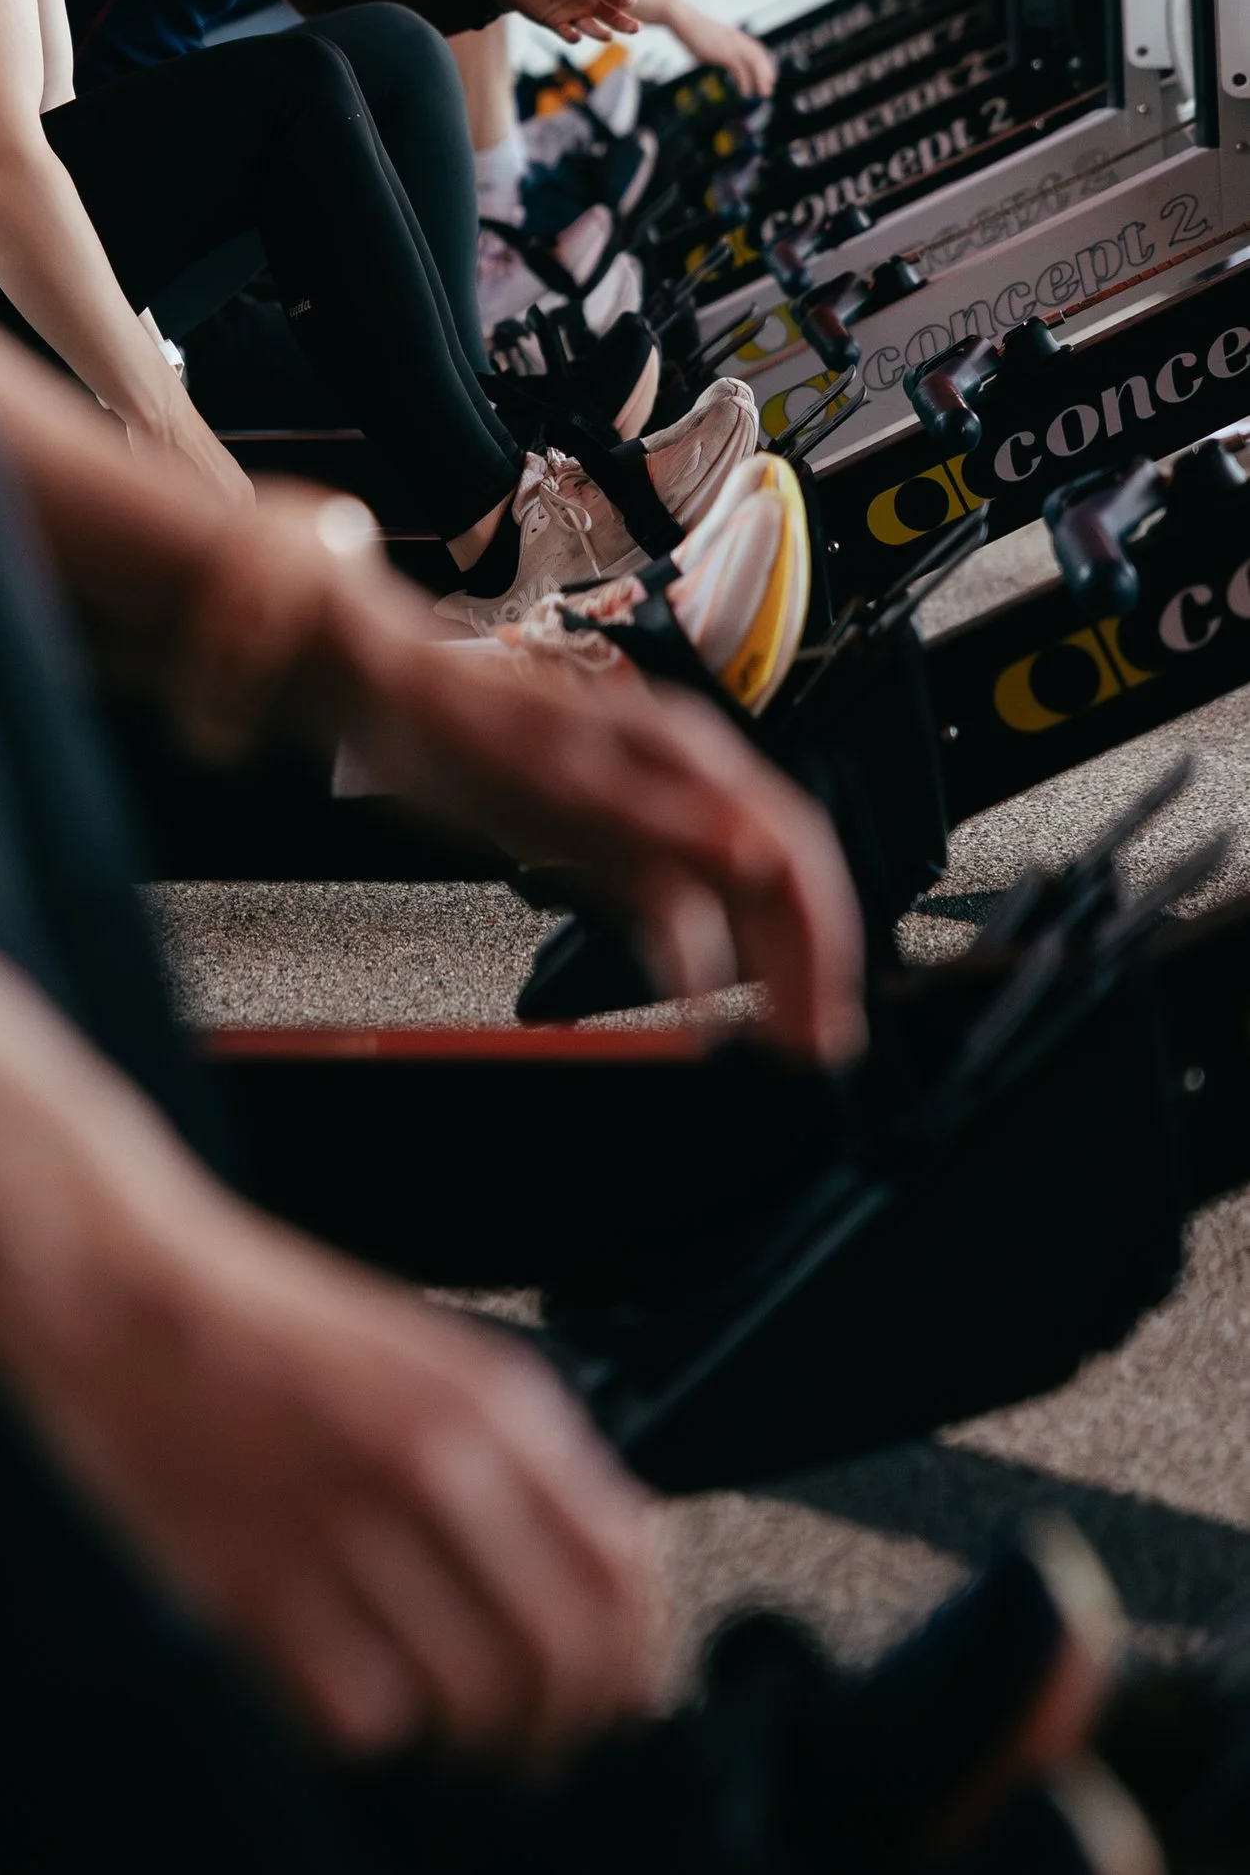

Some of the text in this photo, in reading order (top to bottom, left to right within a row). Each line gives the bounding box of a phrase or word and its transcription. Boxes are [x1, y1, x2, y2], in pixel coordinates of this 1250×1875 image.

[980, 96, 1015, 135] 2
[862, 193, 1213, 392] concept 2
[994, 326, 1250, 482] conce
